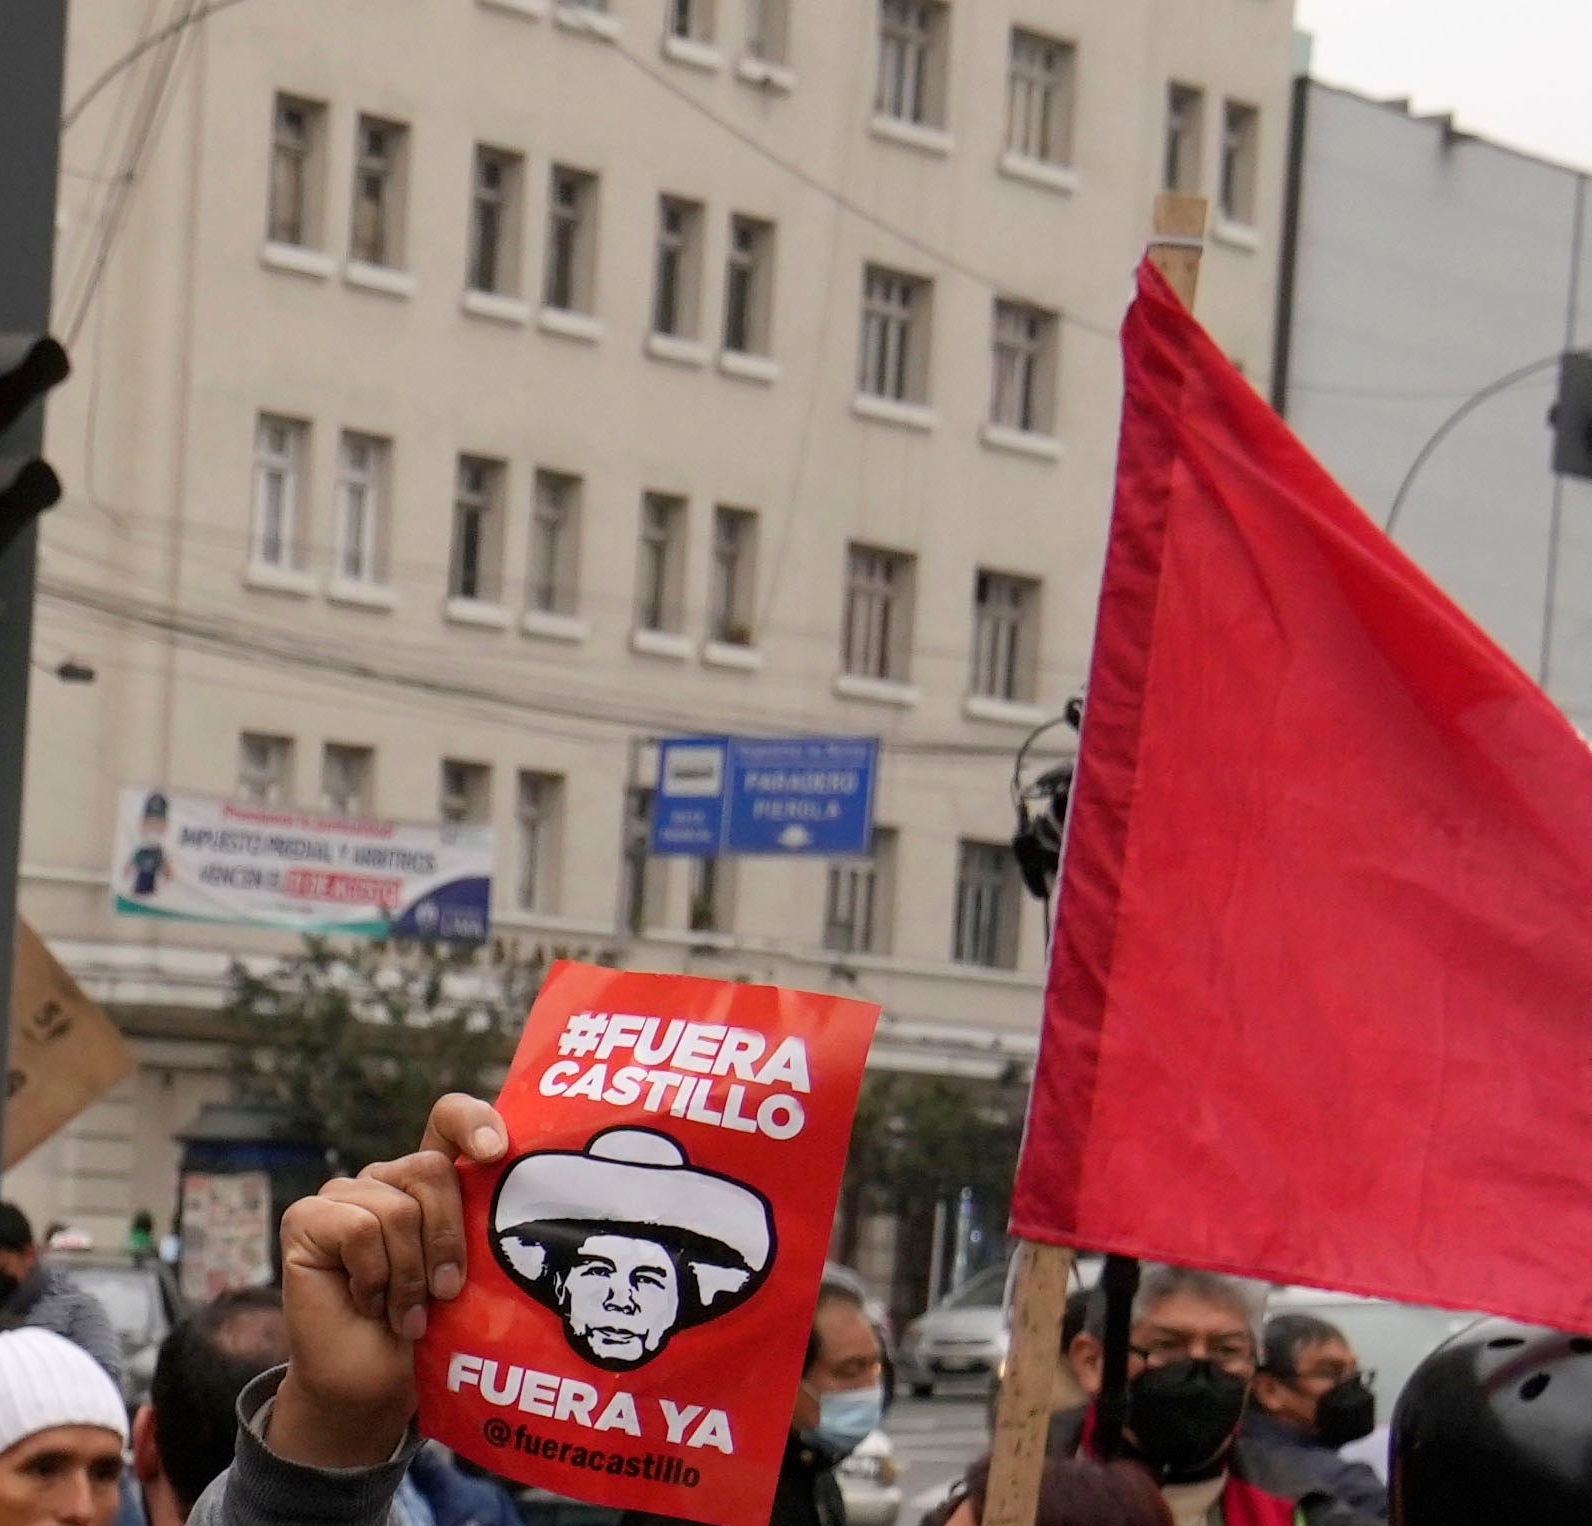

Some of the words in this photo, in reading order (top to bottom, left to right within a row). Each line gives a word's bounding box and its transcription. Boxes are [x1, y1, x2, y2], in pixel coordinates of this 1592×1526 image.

[557, 1012, 812, 1094] #FUERA
[538, 1060, 806, 1140] CASTILLO
[446, 1353, 643, 1438] FUERA
[658, 1399, 735, 1455] YA
[482, 1417, 702, 1489] @fueracastillo
